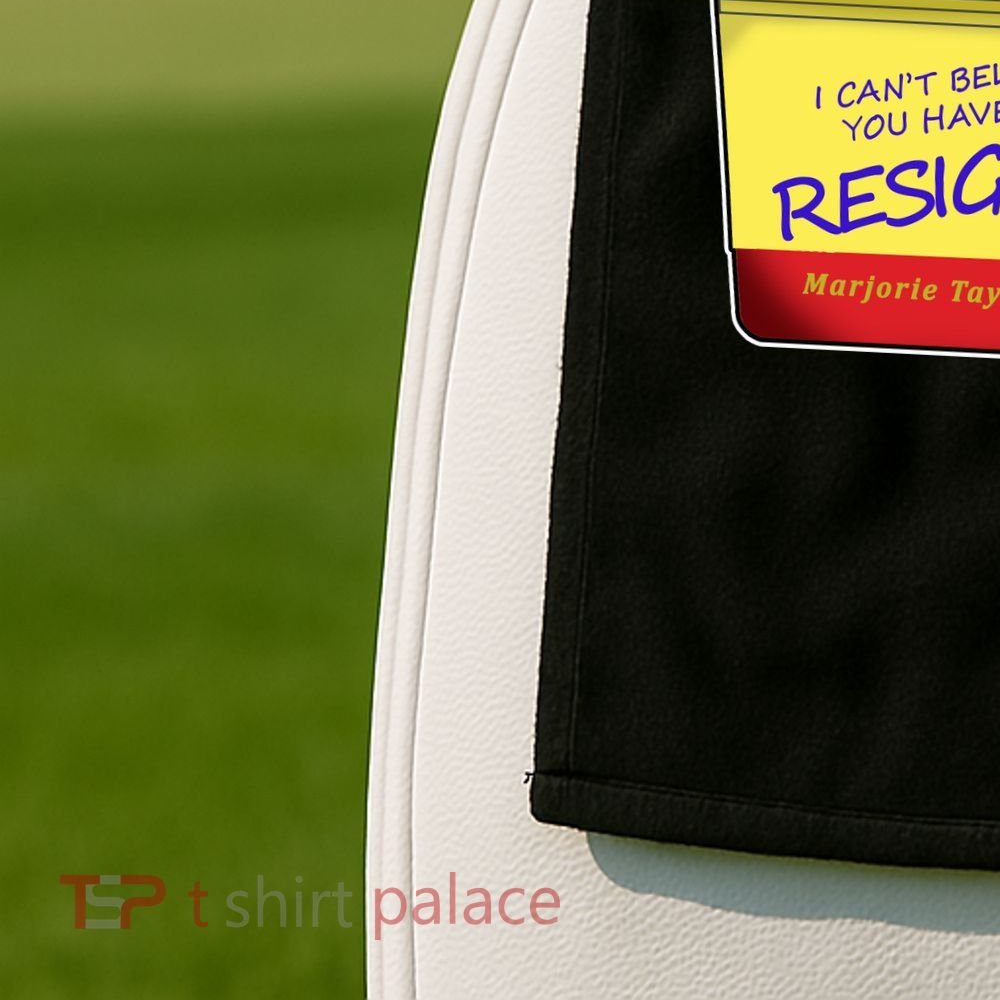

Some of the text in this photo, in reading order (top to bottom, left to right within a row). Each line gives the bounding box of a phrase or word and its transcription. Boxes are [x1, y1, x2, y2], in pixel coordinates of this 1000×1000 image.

[815, 85, 822, 110] I
[837, 72, 938, 109] CAN'T
[841, 110, 908, 142] YOU
[802, 272, 938, 304] Marjorie
